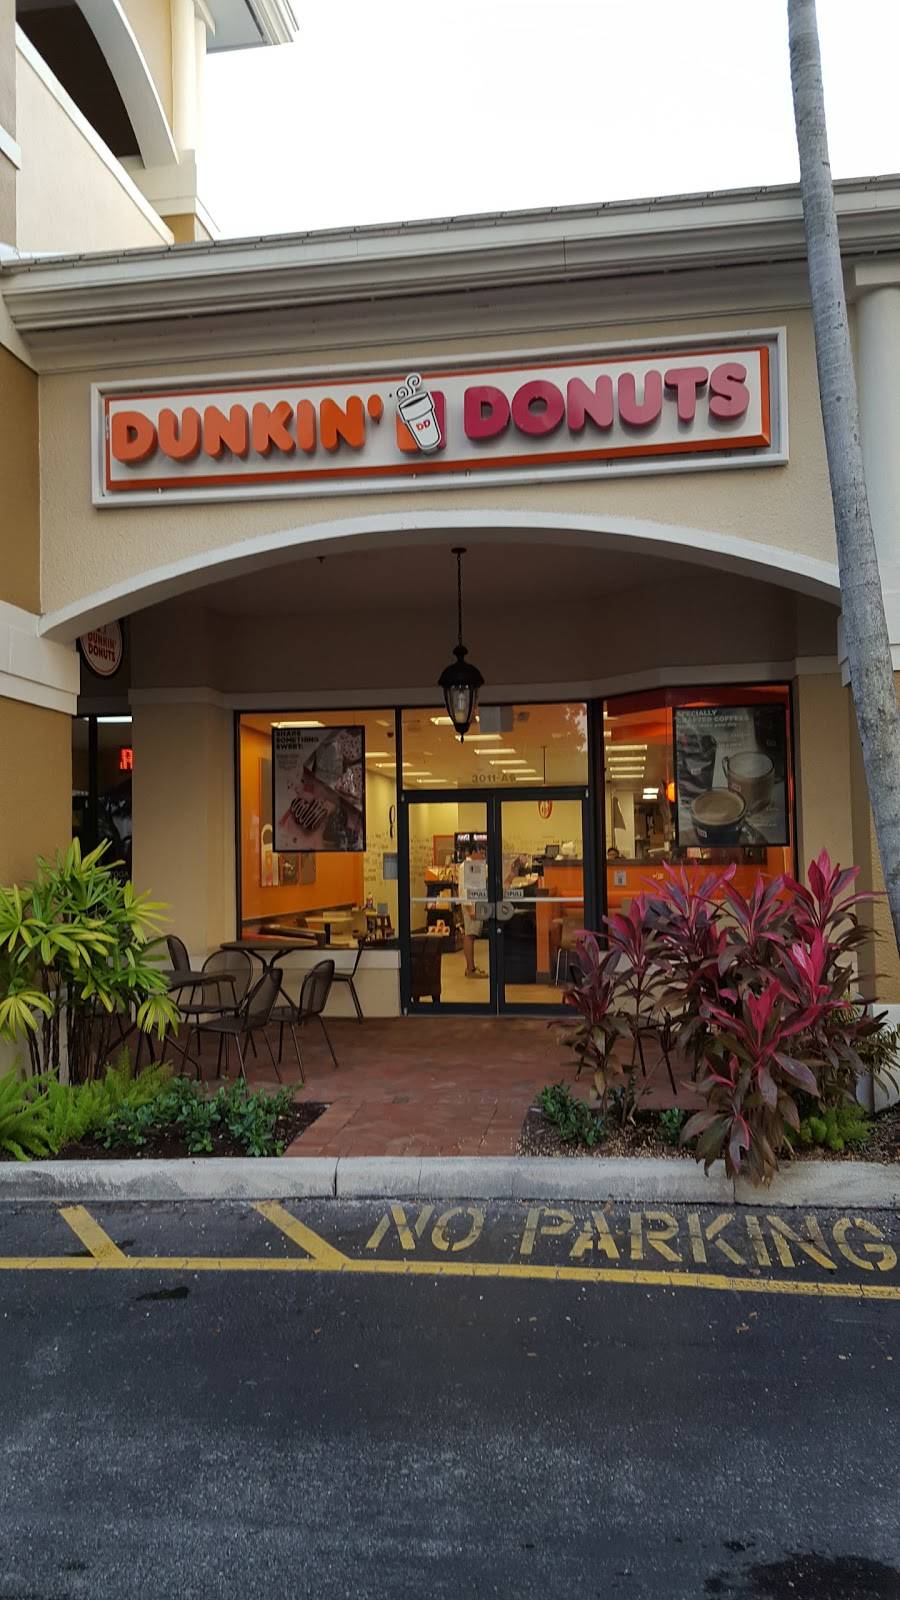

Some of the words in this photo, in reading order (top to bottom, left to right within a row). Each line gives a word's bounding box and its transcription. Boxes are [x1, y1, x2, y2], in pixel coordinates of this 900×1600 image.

[111, 394, 384, 465] DUNKIN'
[463, 362, 751, 442] DONUTS
[416, 418, 432, 434] DD
[88, 642, 116, 662] DONUTS
[365, 1203, 486, 1251] NO
[518, 1207, 899, 1272] PARKING
